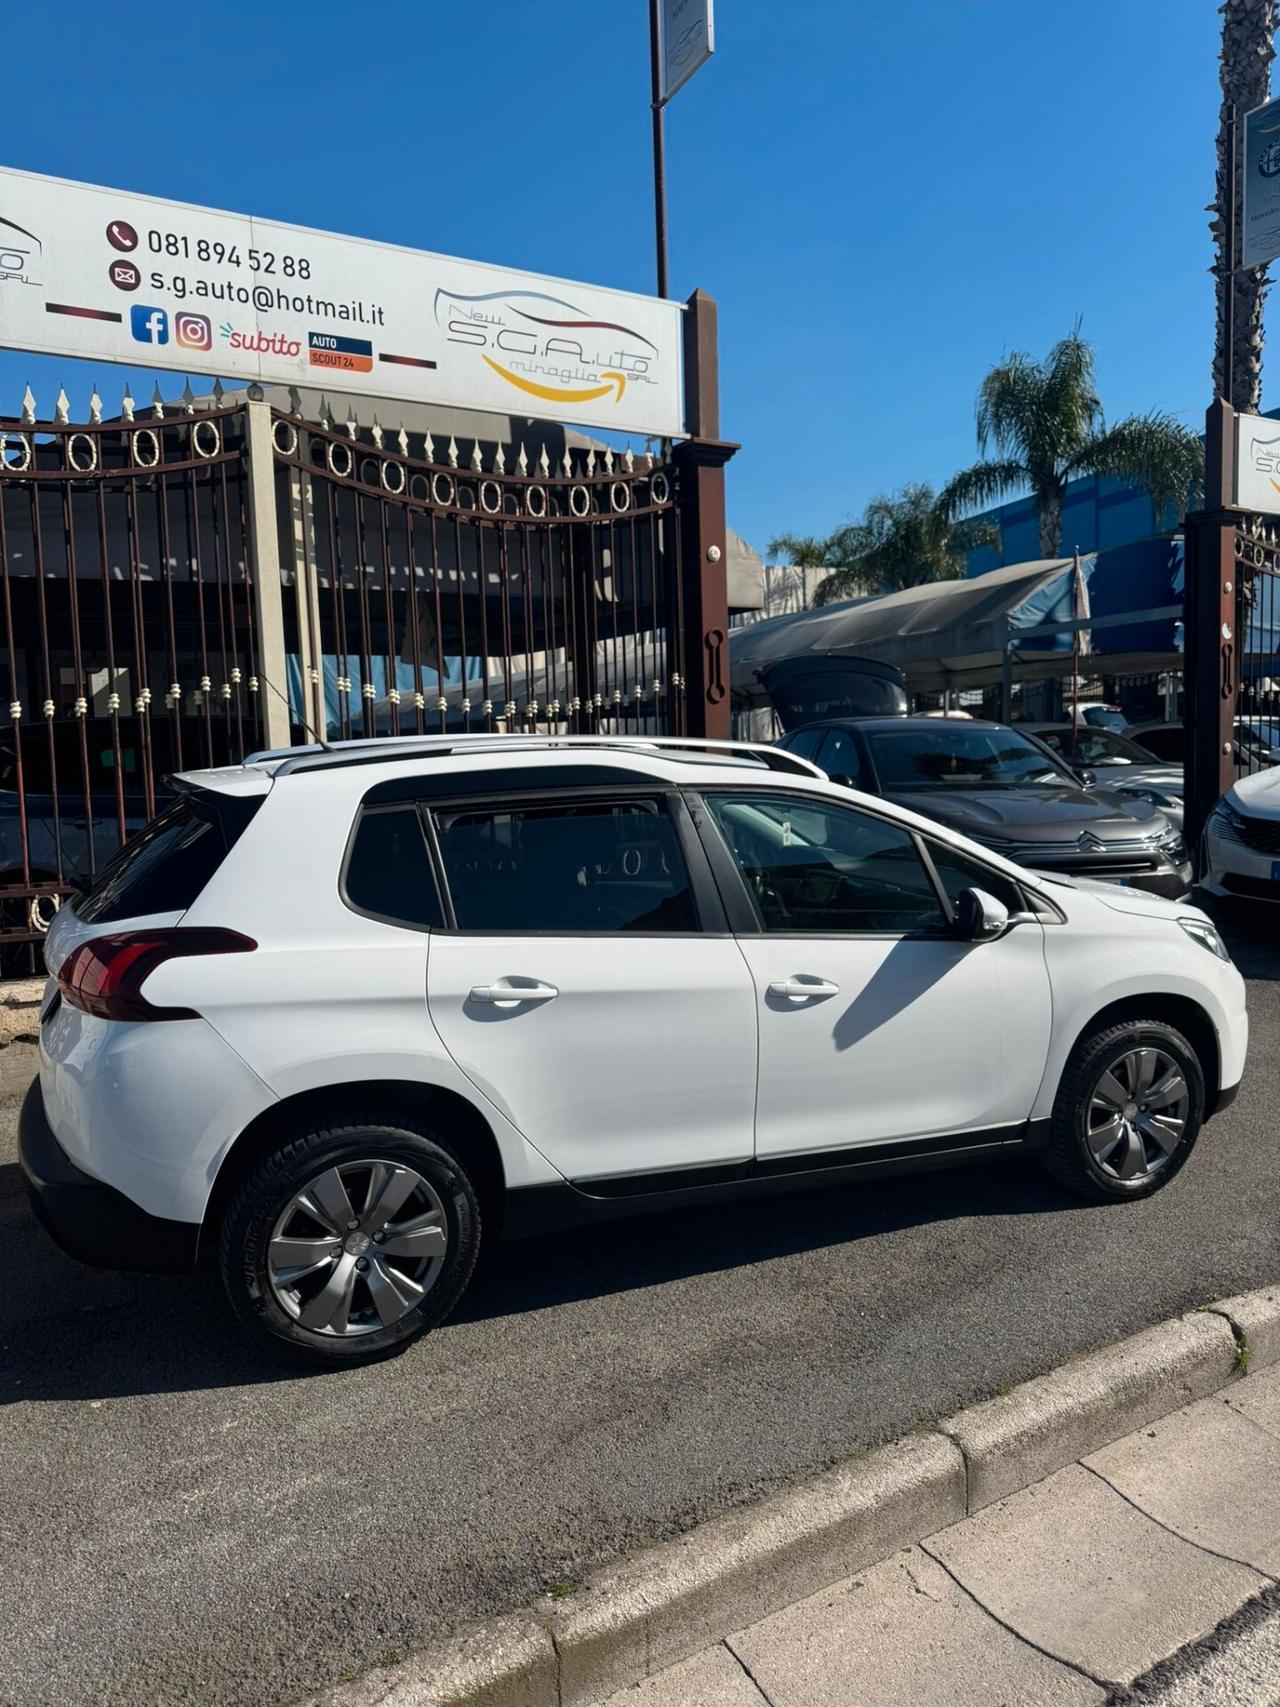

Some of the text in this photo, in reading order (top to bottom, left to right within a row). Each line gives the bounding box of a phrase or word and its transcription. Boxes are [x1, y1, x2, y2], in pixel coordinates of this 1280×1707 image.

[148, 230, 311, 280] 081 894 52 88
[150, 272, 385, 326] s.g.auto@hotmail.it
[229, 330, 302, 357] subito
[312, 335, 337, 349] AUTO
[312, 352, 354, 368] SCOUT 24
